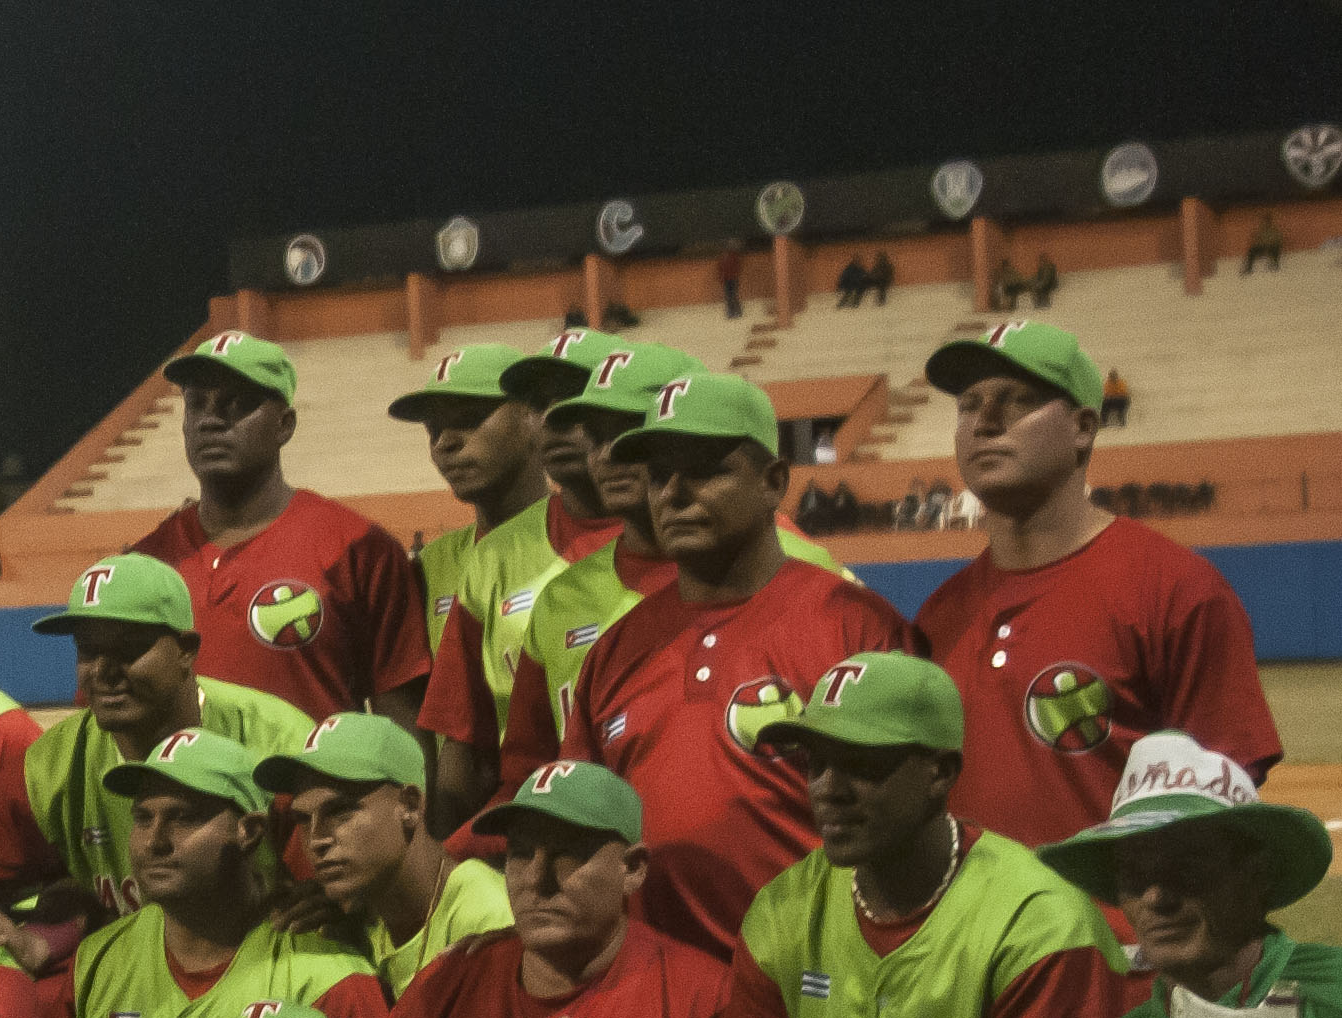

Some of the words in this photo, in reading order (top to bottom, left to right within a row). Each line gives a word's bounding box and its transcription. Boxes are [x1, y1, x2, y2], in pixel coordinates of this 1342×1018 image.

[211, 331, 244, 355] T
[551, 331, 585, 359] T
[987, 322, 1026, 348] T
[435, 351, 464, 381] T
[594, 351, 632, 387] T
[656, 379, 690, 420] T
[81, 565, 115, 604] T
[820, 664, 866, 706] T
[157, 728, 200, 762] T
[304, 713, 341, 751] T
[531, 759, 576, 793] T
